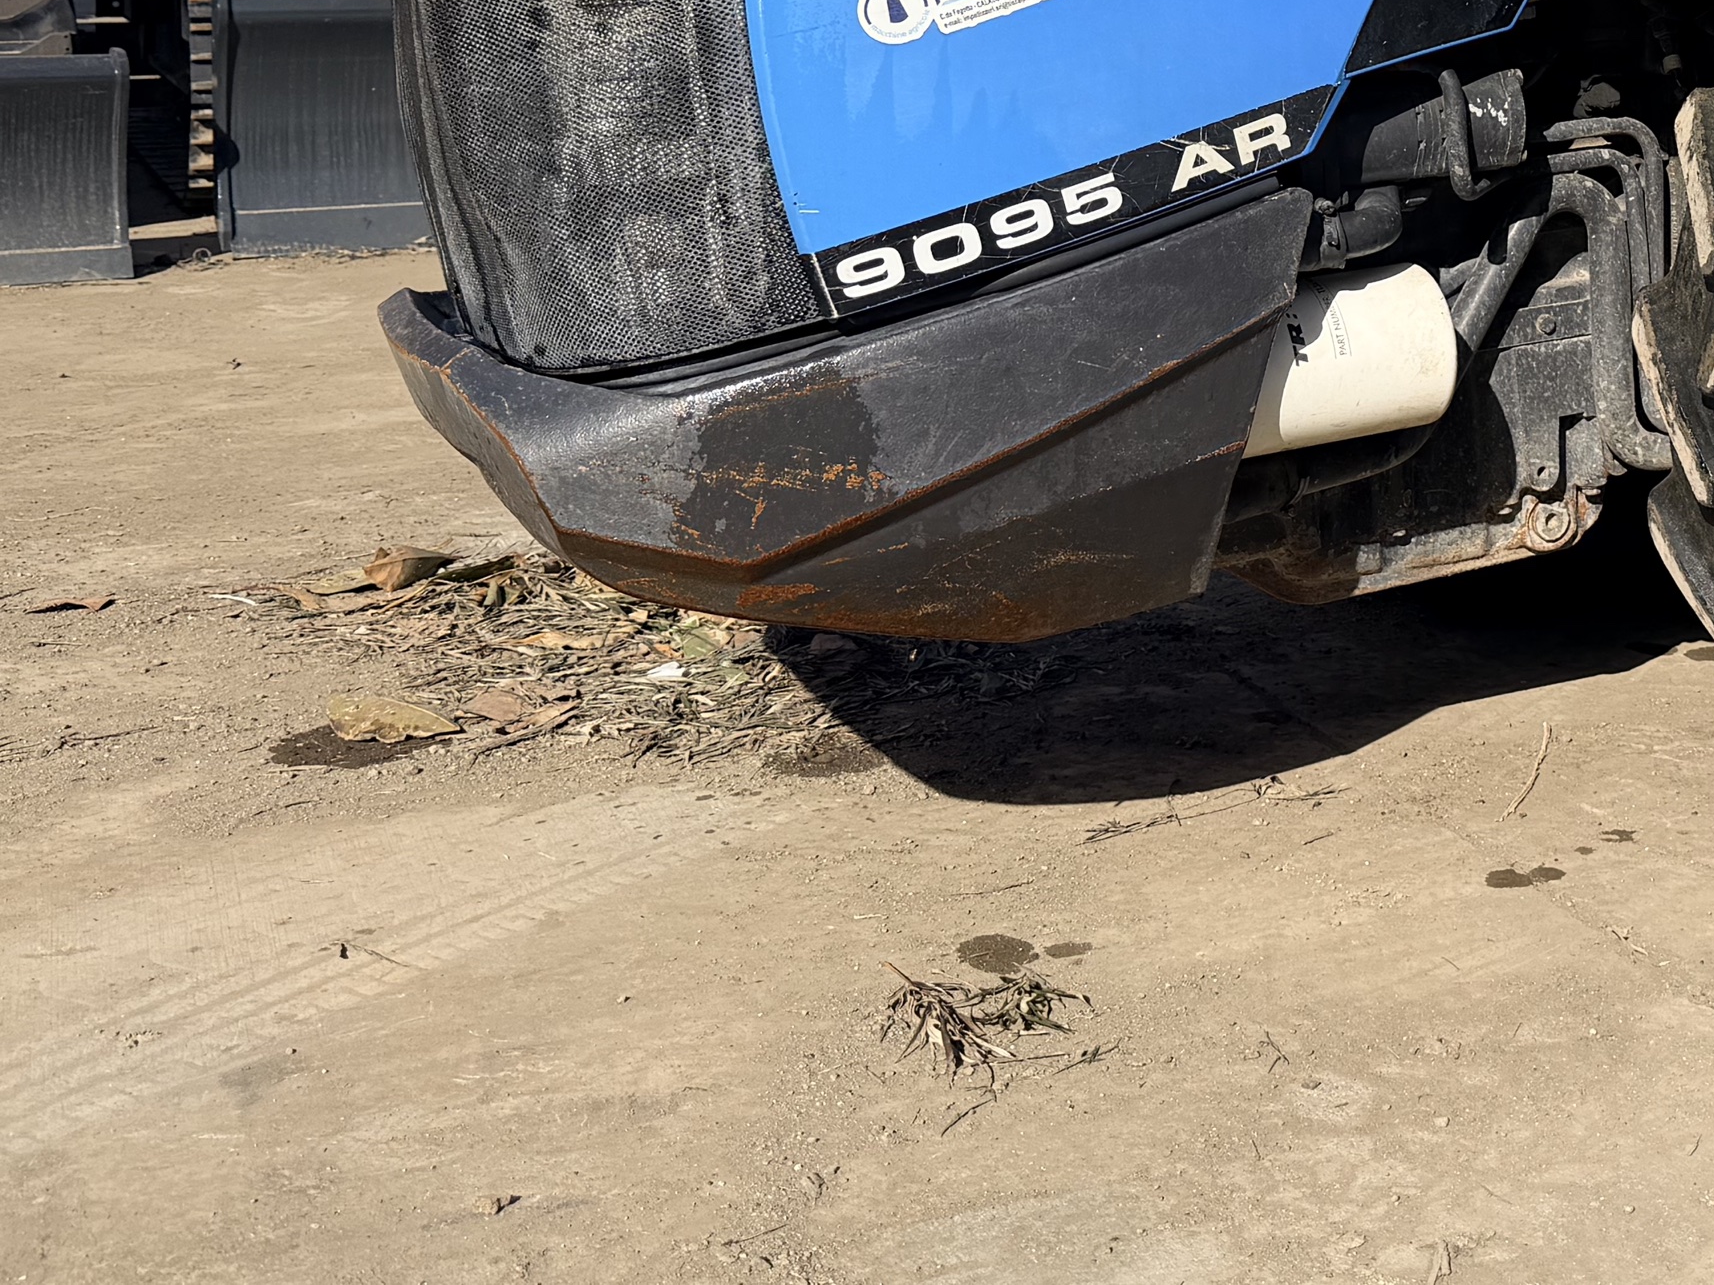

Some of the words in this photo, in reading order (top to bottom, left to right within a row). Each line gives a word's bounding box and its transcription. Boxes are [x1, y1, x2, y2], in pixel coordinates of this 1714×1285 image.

[836, 172, 1123, 298] 9095
[1171, 112, 1292, 192] AR
[1335, 334, 1348, 356] PART
